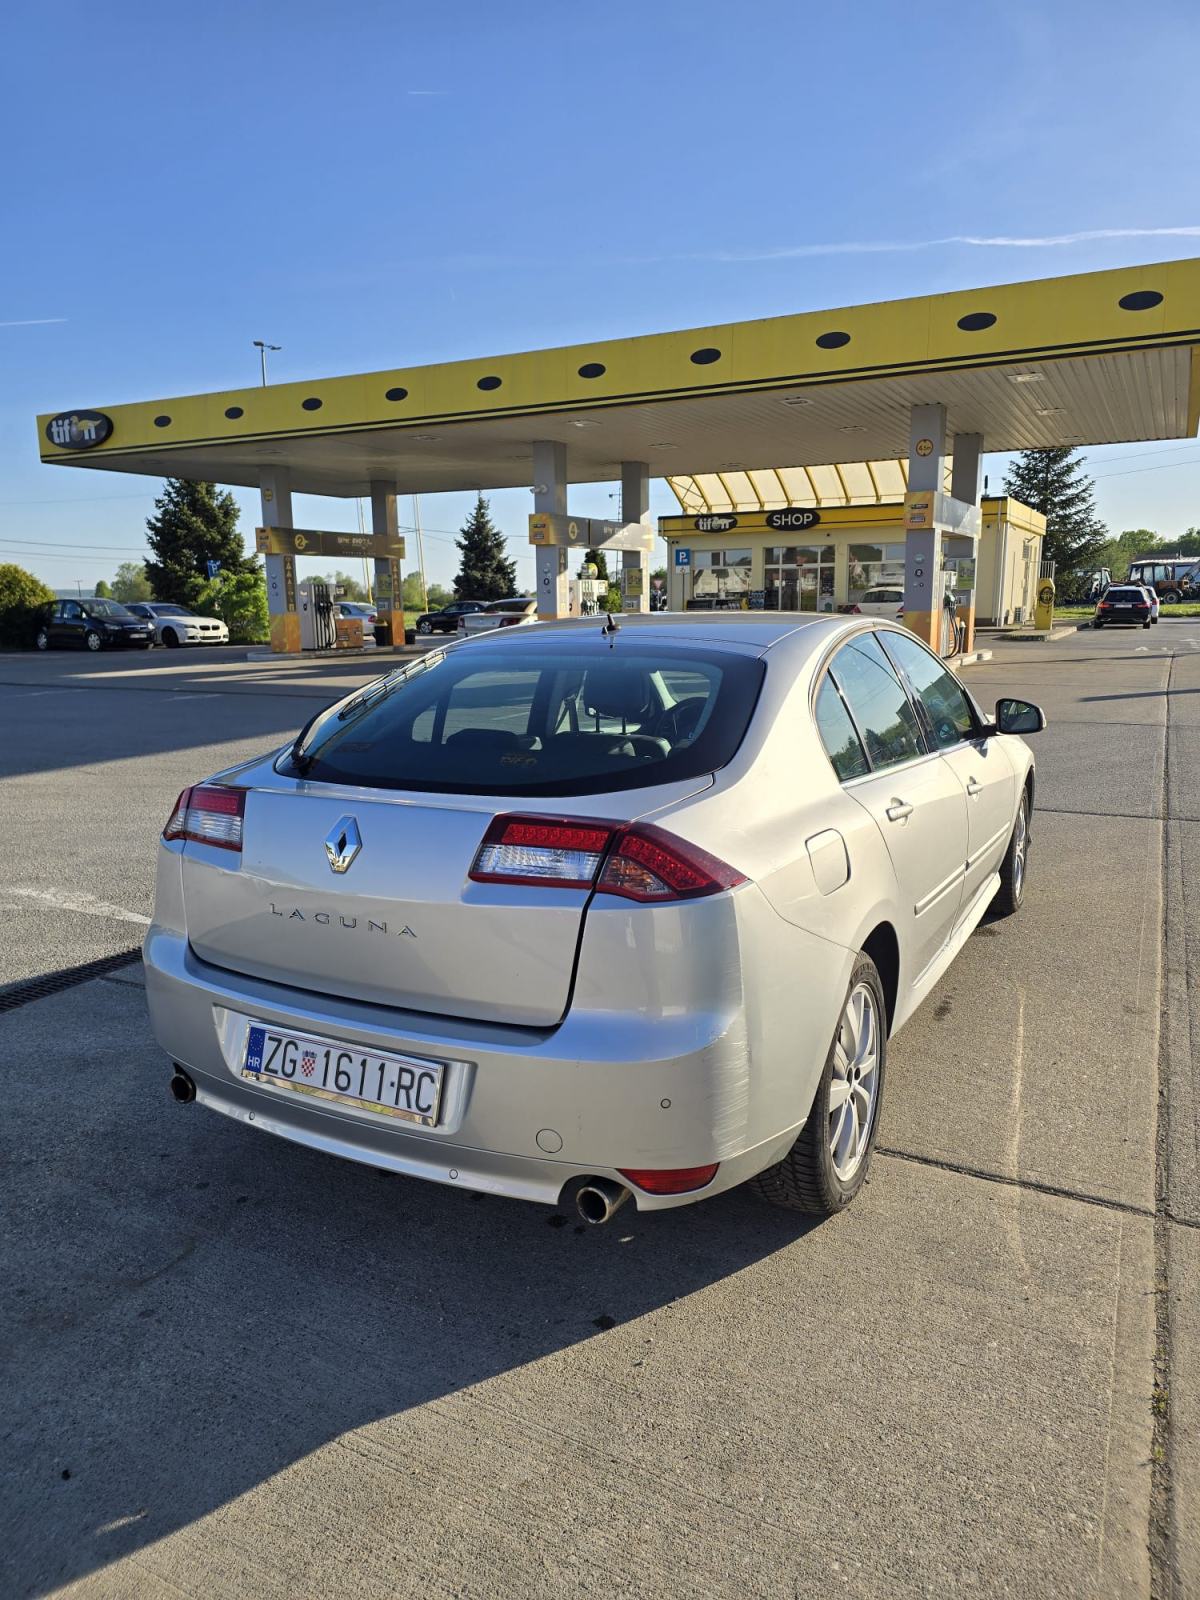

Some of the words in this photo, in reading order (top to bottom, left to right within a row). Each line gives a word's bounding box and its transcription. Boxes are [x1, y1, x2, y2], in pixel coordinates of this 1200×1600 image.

[772, 513, 813, 526] SHOP
[297, 536, 304, 547] 2
[269, 902, 418, 938] LAGUNA
[247, 1055, 261, 1068] HR
[263, 1036, 299, 1078] ZG
